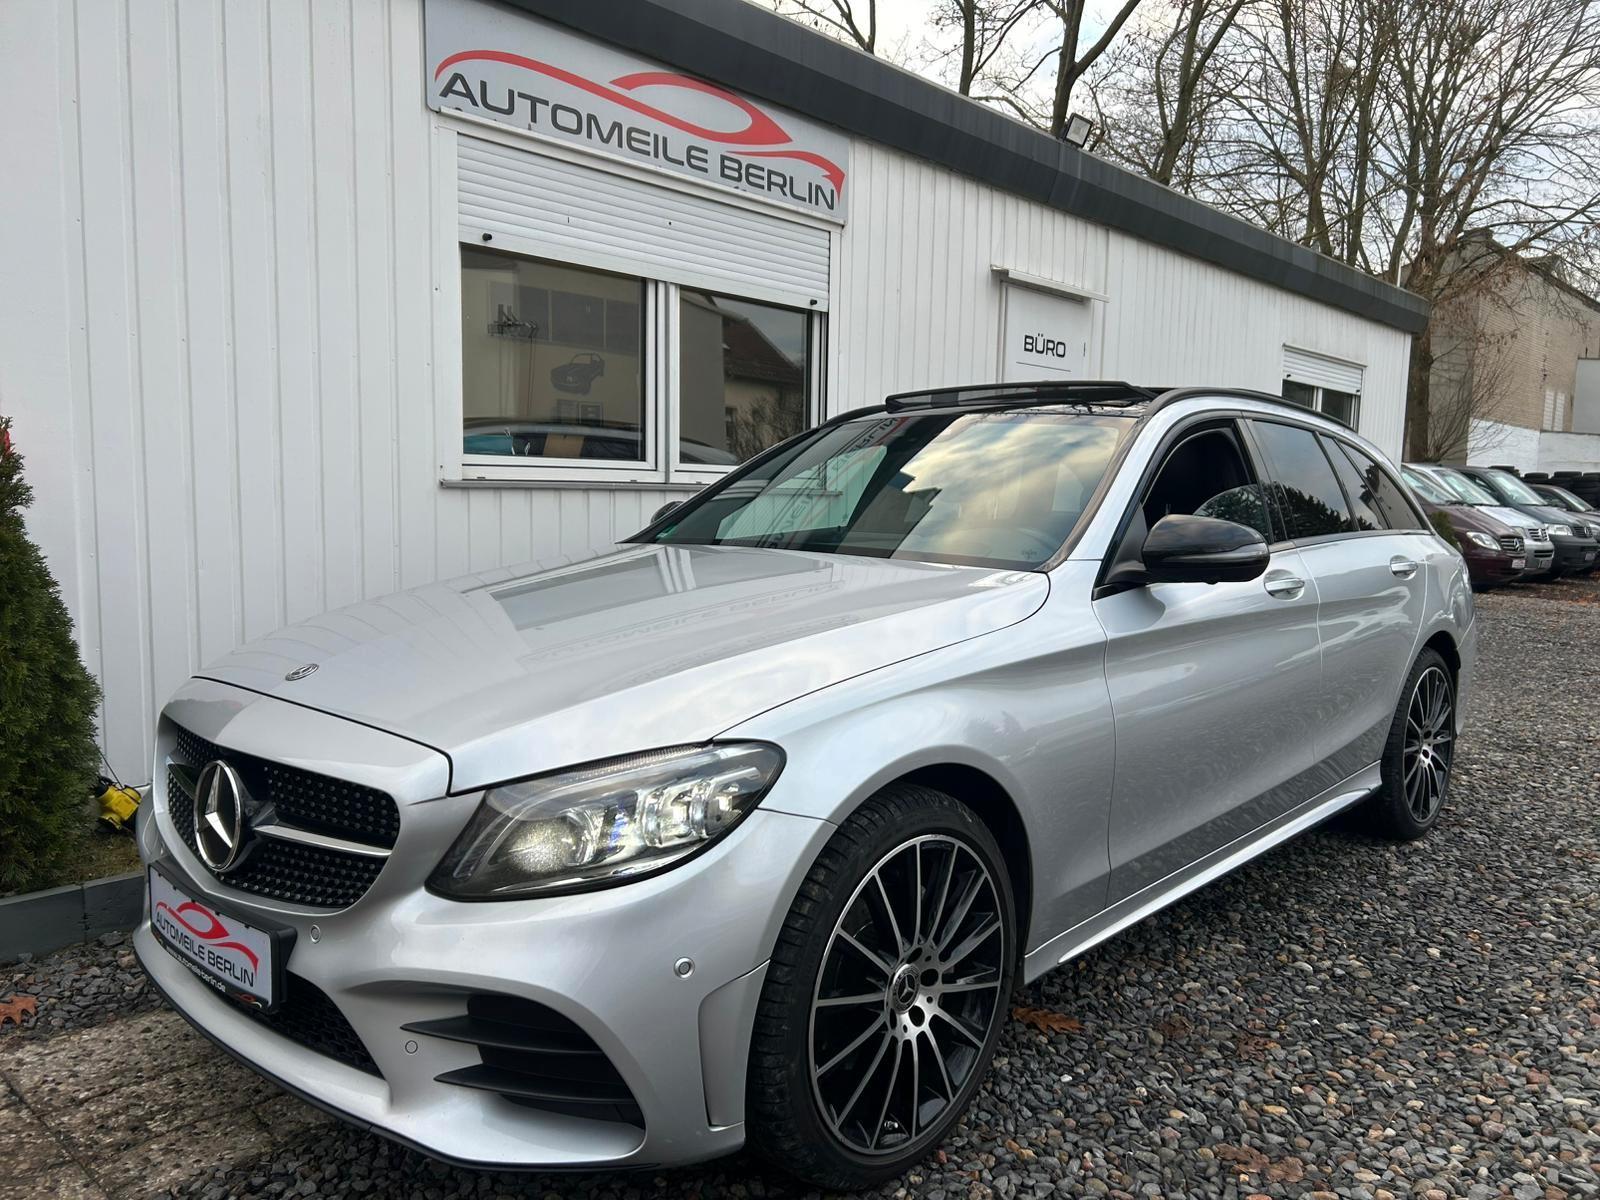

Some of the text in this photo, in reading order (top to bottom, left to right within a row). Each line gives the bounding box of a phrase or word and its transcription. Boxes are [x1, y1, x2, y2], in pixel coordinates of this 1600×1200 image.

[439, 72, 836, 211] AUTOMEILE BERLIN
[1023, 333, 1066, 358] BÜRO
[156, 911, 254, 987] AUTOMEILE BERLIN
